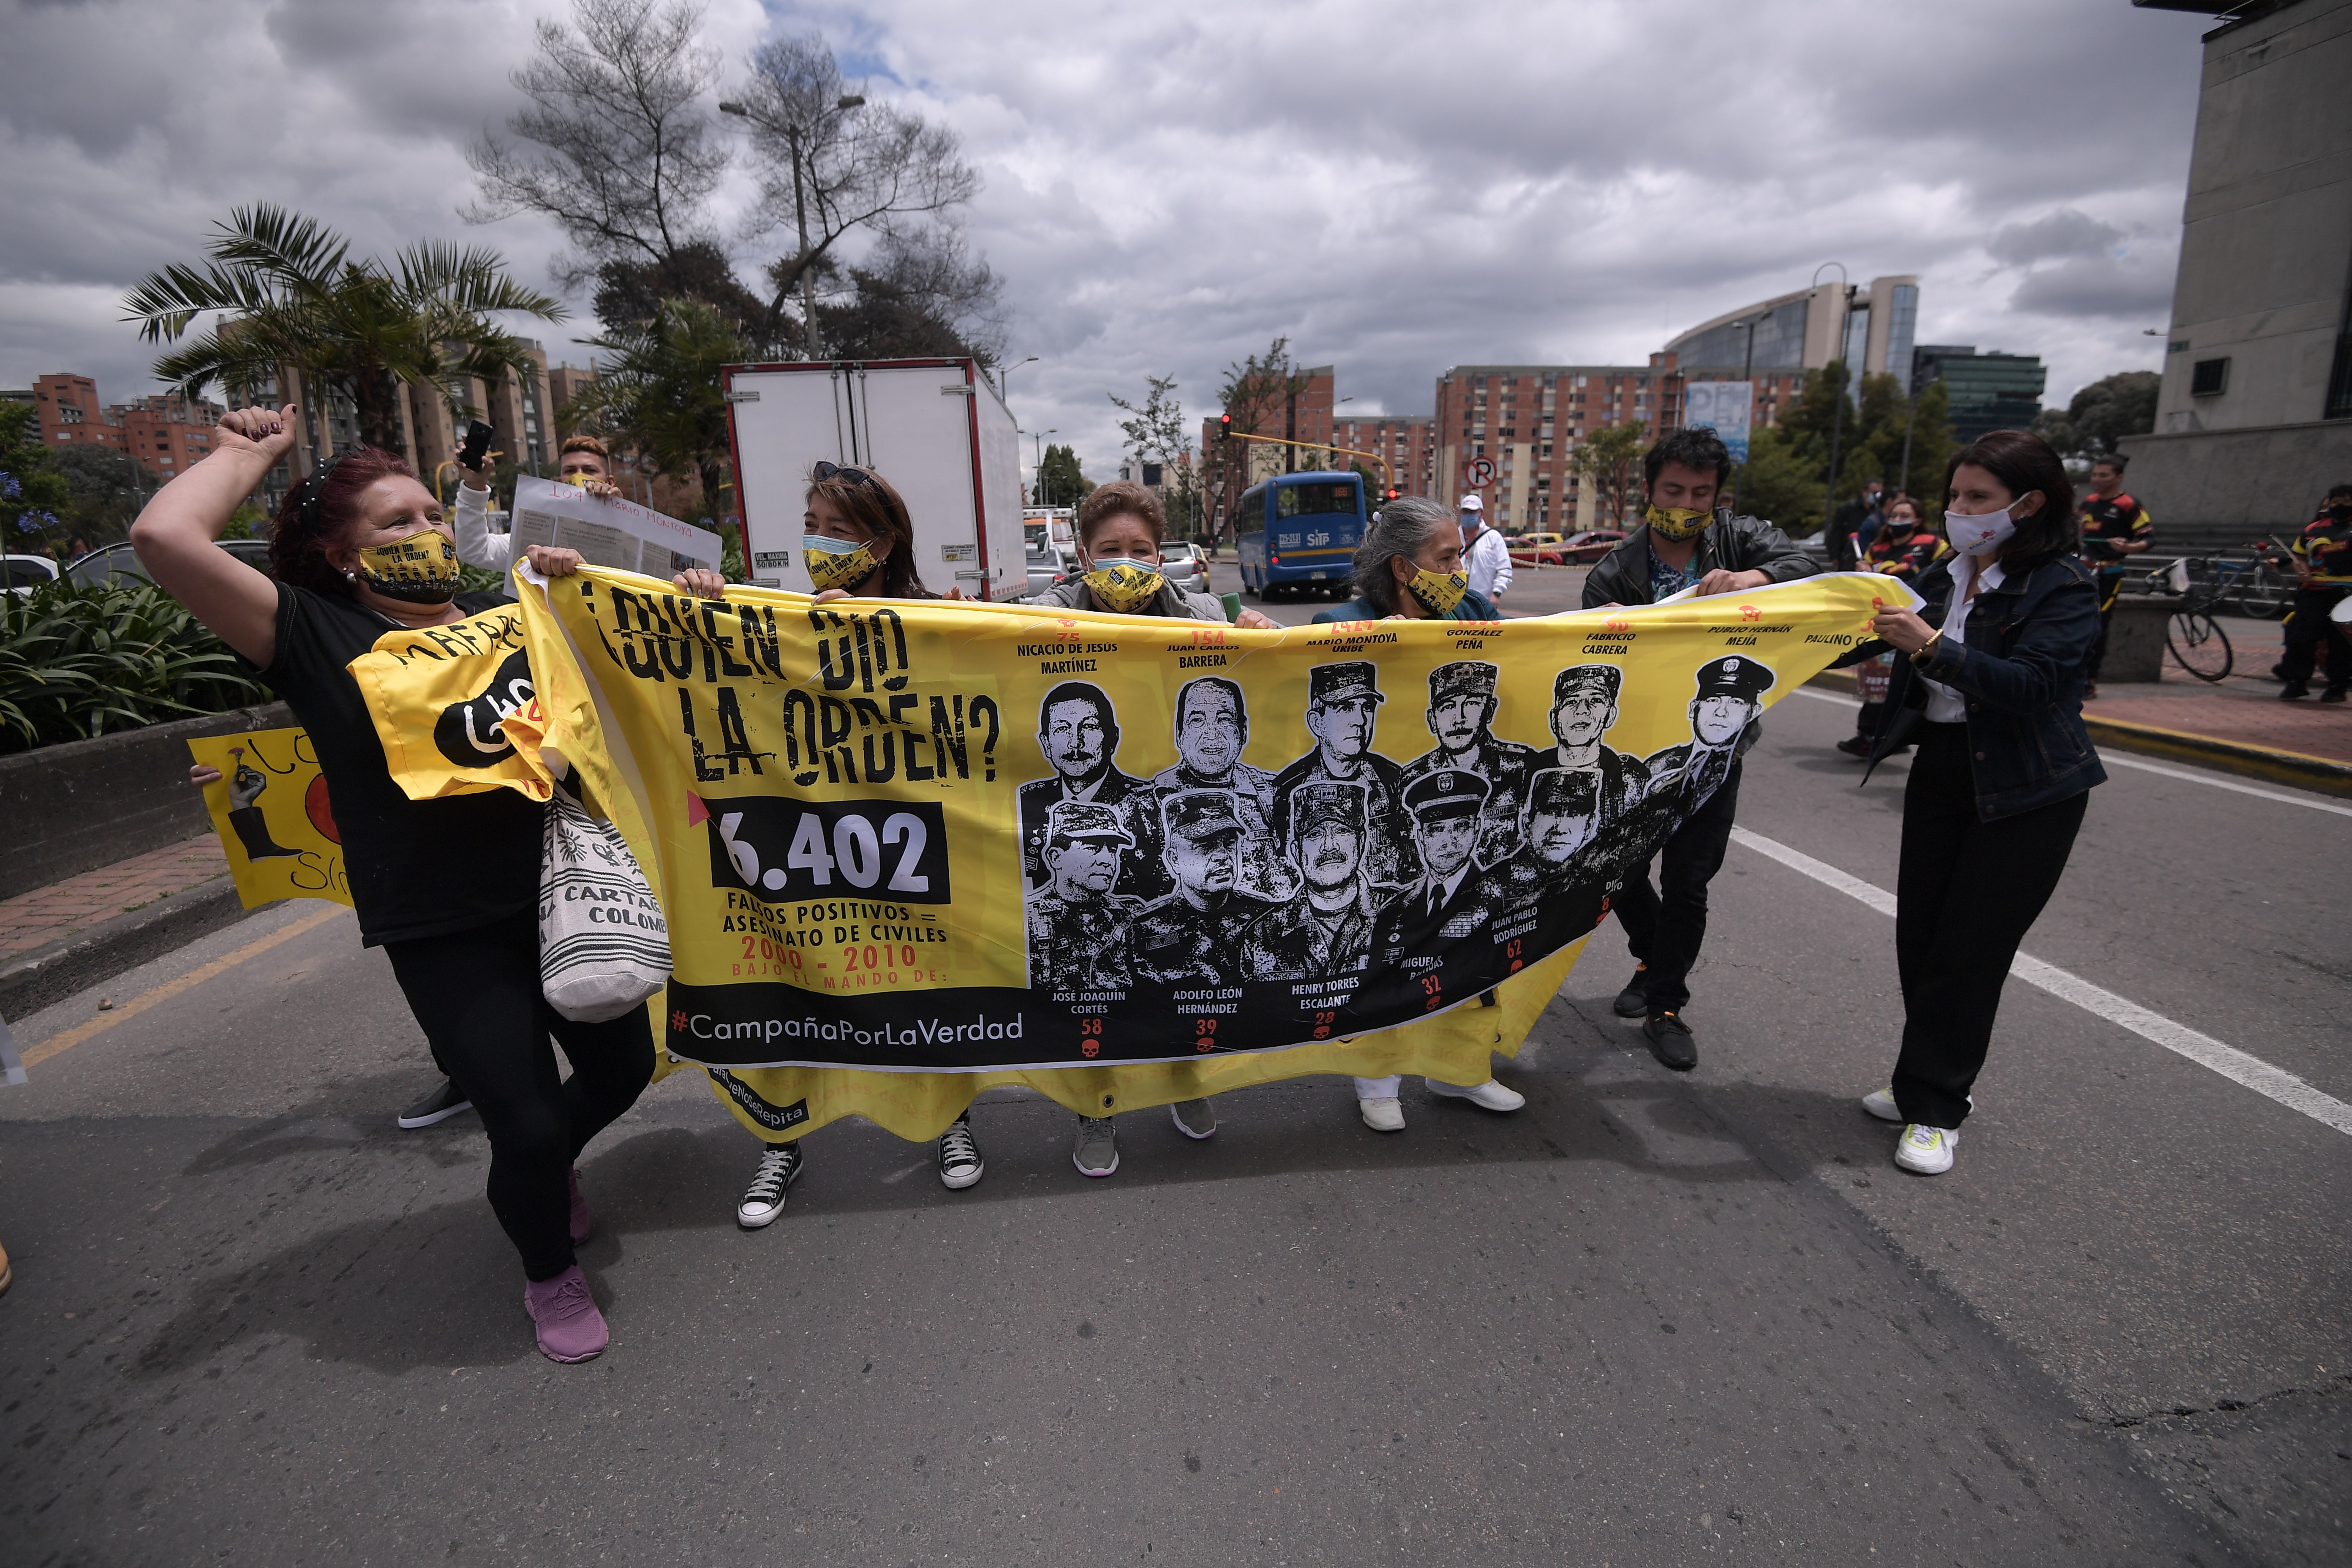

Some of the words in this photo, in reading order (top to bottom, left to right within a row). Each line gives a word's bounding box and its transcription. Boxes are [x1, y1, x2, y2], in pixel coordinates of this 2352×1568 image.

[550, 485, 582, 501] 104
[376, 545, 400, 556] ¿QUIÉN
[403, 543, 414, 552] DIO
[392, 555, 403, 563] LA
[405, 550, 429, 561] ORDEN?
[811, 560, 830, 575] ¿QUIÉN
[829, 554, 841, 563] DIO
[823, 568, 836, 577] LA
[836, 554, 855, 571] ORDEN?
[1111, 570, 1123, 584] 6402
[1451, 575, 1465, 588] 6402
[1447, 627, 1504, 636] GONZÁLEZ
[1585, 632, 1636, 641] FABRICIO
[1748, 624, 1794, 633] HERNÁN
[1056, 632, 1080, 642] 75
[1191, 630, 1225, 645] 154
[1345, 632, 1397, 644] MONTOYA
[1456, 637, 1483, 650] PEÑA
[1725, 634, 1758, 645] MEJÍA
[1804, 634, 1852, 646] PAULINO
[808, 608, 909, 693] DIO
[1017, 644, 1064, 657] NICACIO
[1068, 643, 1083, 654] DE
[1085, 641, 1118, 654] JESÚS
[1332, 645, 1365, 653] URIBE
[1582, 644, 1628, 655] CABRERA
[1041, 656, 1098, 675] MARTÍNEZ
[1179, 654, 1227, 669] BARRERA
[678, 686, 776, 782] LA
[783, 689, 999, 787] ORDEN?
[719, 812, 929, 892] 6.402
[727, 892, 787, 924] FALSOS
[797, 902, 910, 924] POSITIVOS
[1491, 915, 1511, 931] JUAN
[1513, 906, 1538, 922] PABLO
[723, 915, 823, 947] ASESINATO
[834, 925, 860, 944] DE
[871, 924, 947, 942] CIVILES
[1493, 919, 1538, 945] RODRÍGUEZ
[741, 935, 802, 970] 2000
[843, 944, 916, 972] 2010
[1506, 939, 1522, 958] 62
[1400, 956, 1434, 969] MIGUEL
[732, 963, 783, 976] BAJO
[794, 971, 811, 986] EL
[824, 971, 898, 989] MANDO
[914, 969, 947, 983] DE:
[1291, 983, 1324, 996] HENRY
[1325, 976, 1360, 992] TORRES
[1421, 974, 1442, 995] 32
[1052, 989, 1076, 1002] JOSÉ
[1078, 988, 1125, 1002] JOAQUÍN
[1173, 990, 1216, 1001] ADOLFO
[1217, 985, 1243, 999] LEÓN
[1070, 1002, 1108, 1014] CORTÉS
[1177, 1001, 1239, 1015] HERNÁNDEZ
[1300, 994, 1351, 1010] ESCALANTE
[1315, 1010, 1335, 1026] 28
[672, 1009, 1023, 1045] #CampañaPorLaVerdad
[1081, 1018, 1102, 1035] 58
[1195, 1018, 1217, 1036] 39
